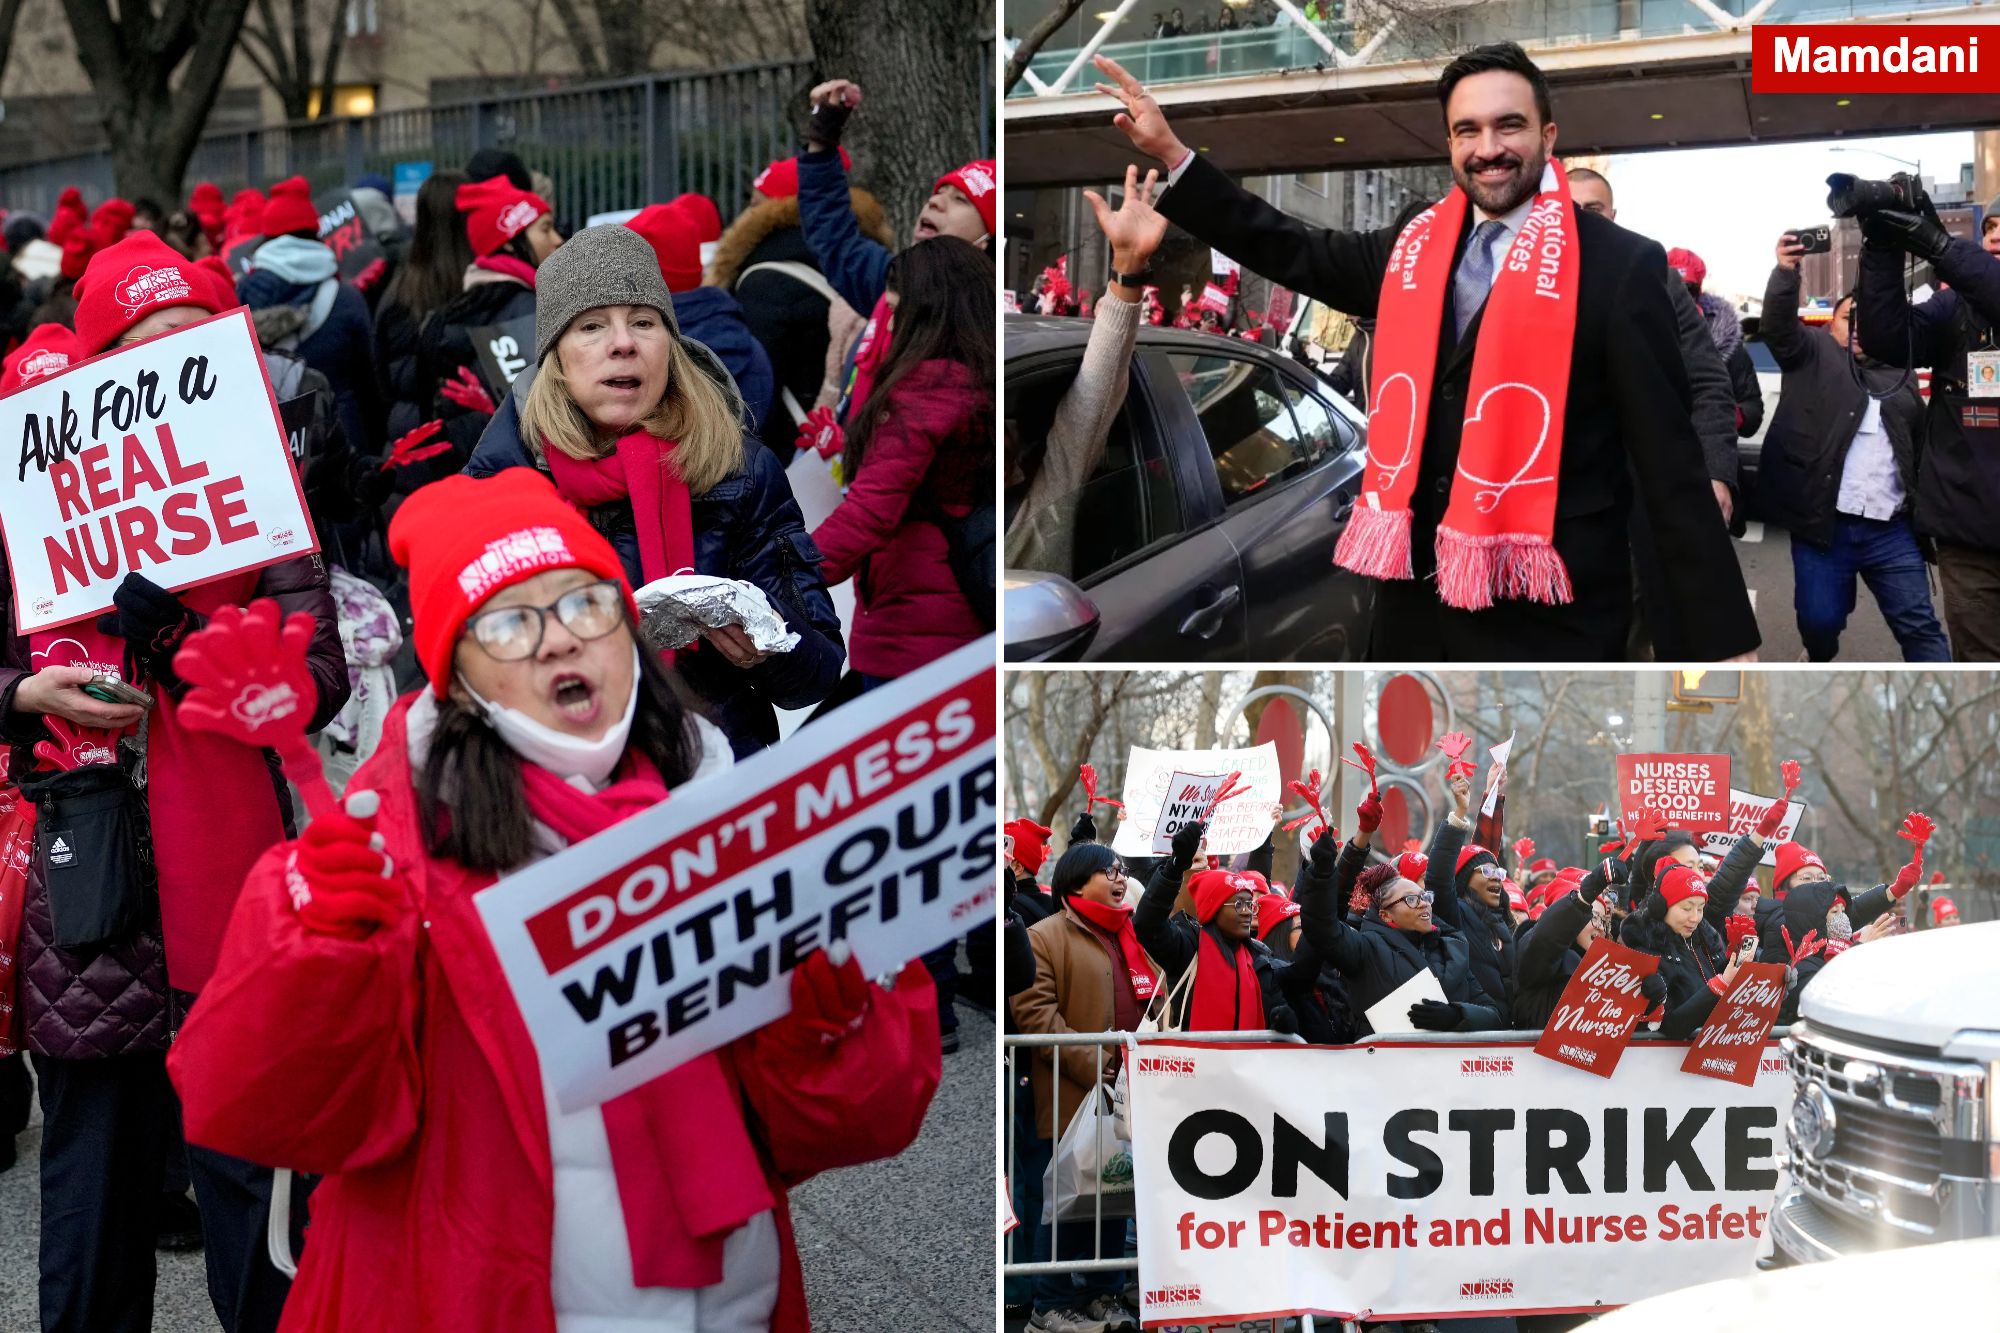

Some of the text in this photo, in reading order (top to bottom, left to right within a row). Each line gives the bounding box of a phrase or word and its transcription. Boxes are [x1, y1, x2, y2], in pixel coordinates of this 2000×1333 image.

[1389, 208, 1436, 273] Nurses
[1508, 204, 1545, 273] Nurses
[1535, 198, 1567, 300] National
[126, 270, 182, 299] NURSES
[18, 390, 82, 482] Ask
[178, 354, 217, 405] a
[48, 422, 210, 523] REAL
[43, 474, 260, 596] NURSE
[70, 659, 119, 672] New York State
[1634, 762, 1711, 779] NURSES
[1178, 784, 1201, 803] We
[1630, 778, 1716, 796] DESERVE
[1168, 803, 1191, 819] NY
[1644, 794, 1700, 811] GOOD
[1668, 810, 1722, 822] BENEFITS
[567, 698, 975, 951] DON'T MESS
[1705, 833, 1719, 844] IS
[50, 846, 70, 854] adidas
[561, 757, 996, 1024] WITH OUR
[610, 825, 996, 1069] BENEFITS
[1553, 1004, 1635, 1039] Nurses!
[1698, 1020, 1770, 1049] Nurses!
[1137, 1058, 1196, 1073] NURSES
[1461, 1060, 1515, 1073] NURSES
[1167, 1106, 1779, 1202] ON STRIKE
[1176, 1211, 1246, 1250] for
[1258, 1209, 1418, 1250] Patient
[1428, 1208, 1511, 1247] and
[1524, 1207, 1647, 1245] Nurse
[1144, 1287, 1202, 1305] NURSES
[1460, 1281, 1515, 1296] NURSES
